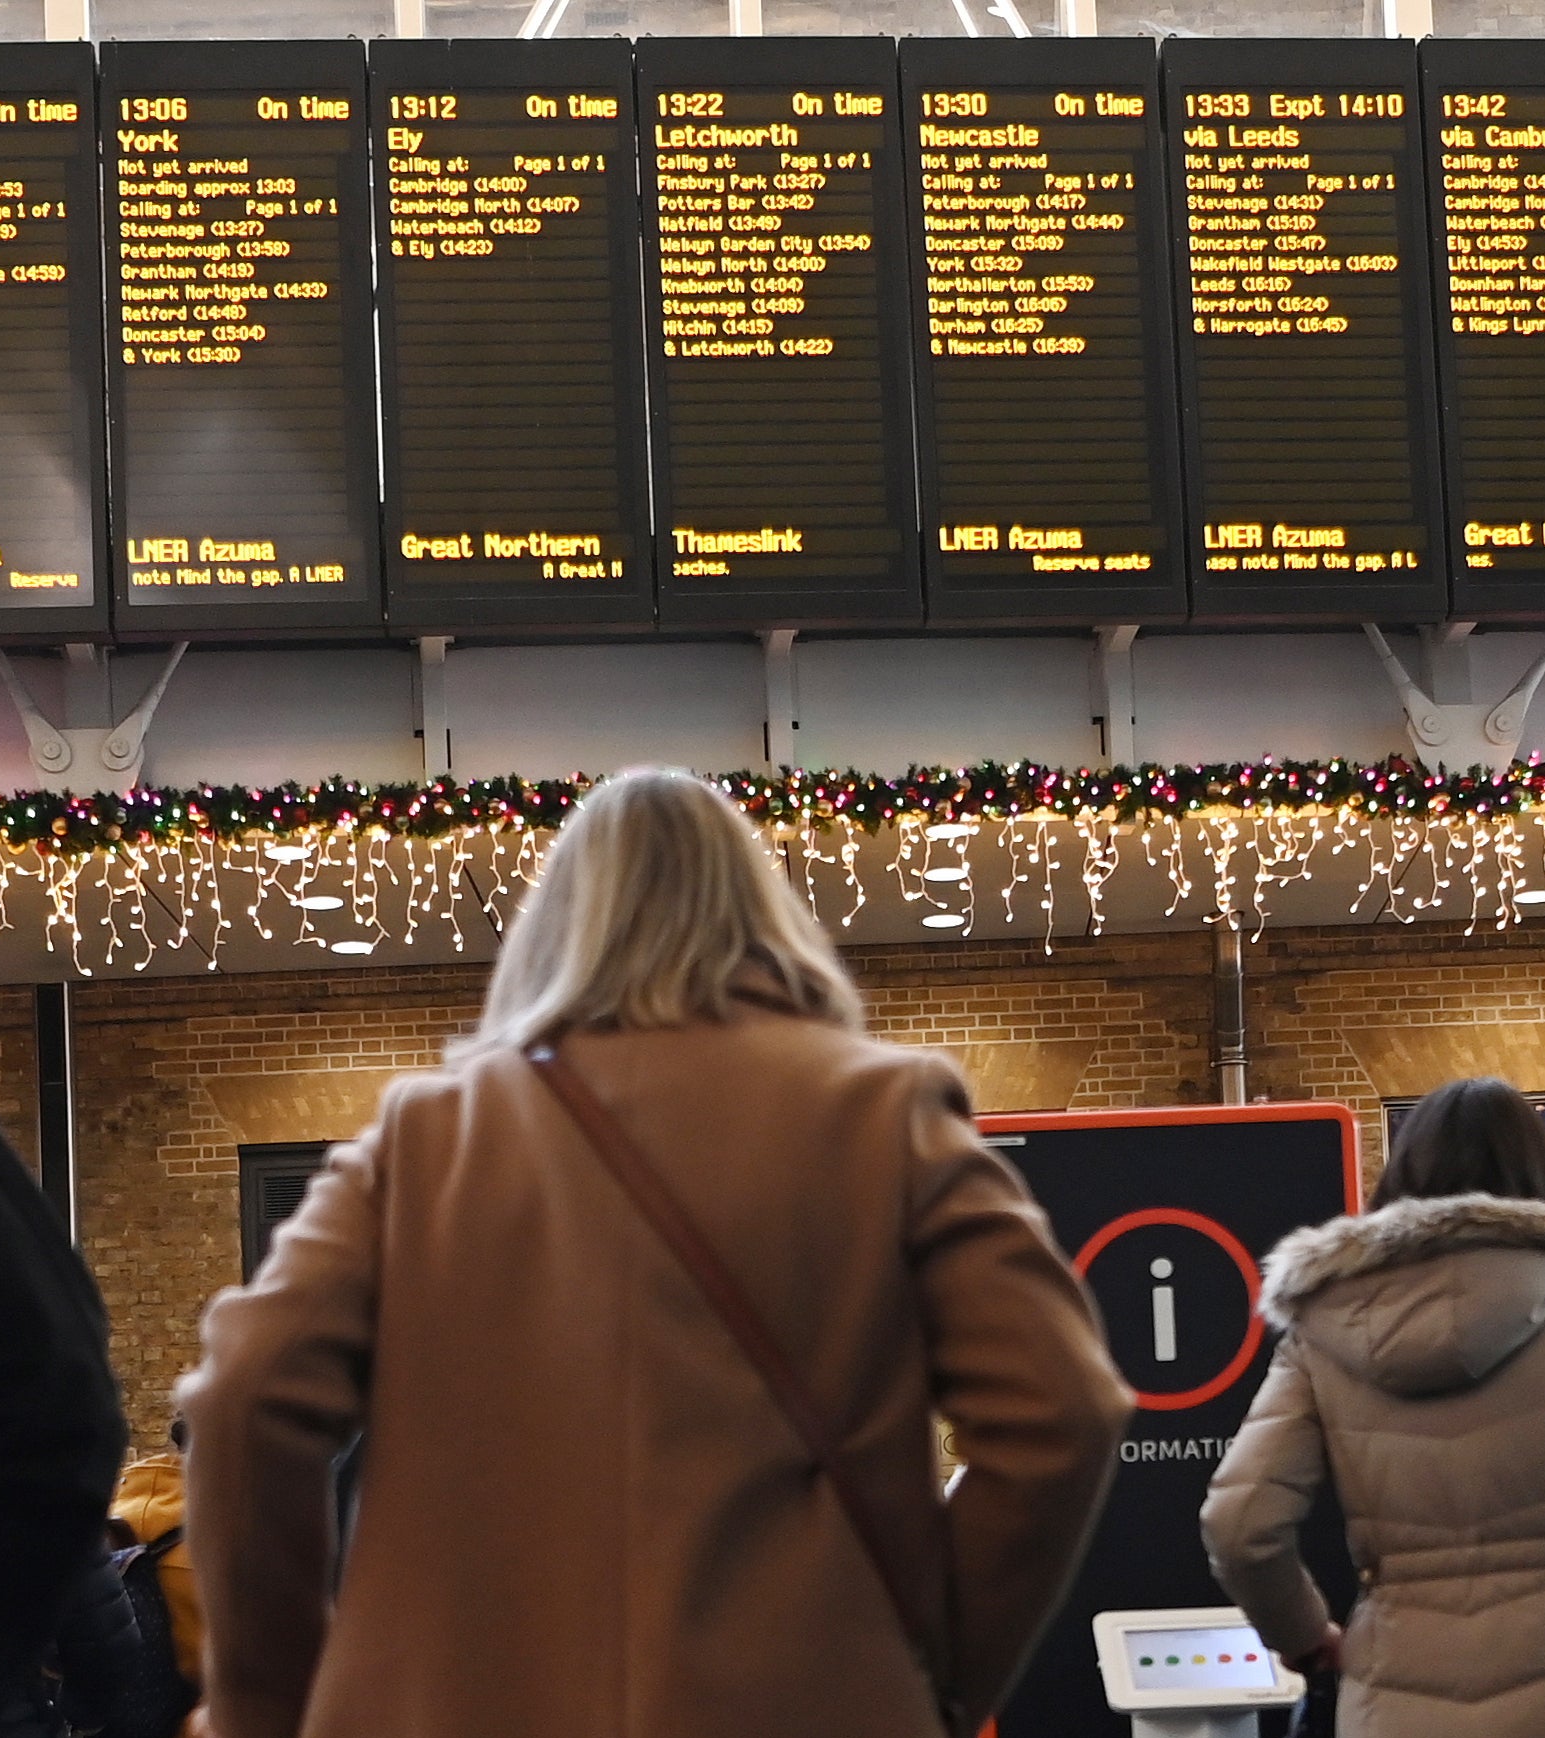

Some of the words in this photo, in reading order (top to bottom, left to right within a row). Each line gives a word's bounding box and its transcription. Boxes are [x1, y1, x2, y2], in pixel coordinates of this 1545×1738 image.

[27, 99, 78, 122] time
[121, 97, 188, 122] 13:06
[257, 96, 289, 120] On
[298, 96, 350, 120] time
[393, 95, 457, 119] 13:12
[526, 95, 558, 118] On
[568, 94, 618, 119] time
[658, 93, 724, 117] 13:22
[792, 92, 824, 116] On
[833, 92, 883, 116] time
[923, 92, 988, 118] 13:30
[1054, 92, 1086, 117] On
[1095, 92, 1144, 117] time
[1186, 93, 1251, 118] 13:33
[1271, 94, 1326, 121] Expt
[1340, 94, 1404, 117] 14:10
[1444, 94, 1507, 118] 13:42
[118, 129, 179, 153] York
[388, 127, 424, 154] Ely
[656, 123, 798, 149] Letchworth
[920, 124, 1040, 148] Newcastle
[1185, 125, 1219, 148] via
[1228, 124, 1300, 148] Leeds
[1442, 125, 1476, 149] via
[120, 159, 147, 176] Not
[152, 160, 182, 178] yet
[188, 160, 249, 175] arrived
[924, 193, 1031, 214] Peterborough
[1035, 193, 1087, 210] (14:17)
[393, 218, 484, 236] Waterbeach
[490, 217, 542, 235] (14:12)
[1452, 295, 1532, 315] Watlington
[930, 314, 987, 335] Durham
[991, 316, 1044, 334] (16:25)
[1453, 316, 1465, 333] &
[1468, 316, 1509, 336] Kings
[401, 533, 474, 559] Great
[483, 531, 601, 558] Northern
[673, 527, 803, 554] Thameslink
[941, 525, 999, 551] LNER
[1008, 524, 1084, 550] Azuma
[1206, 523, 1263, 549] LNER
[1271, 523, 1346, 548] Azuma
[1466, 522, 1534, 546] Great
[128, 537, 189, 565] LNER
[199, 536, 276, 563] Azuma
